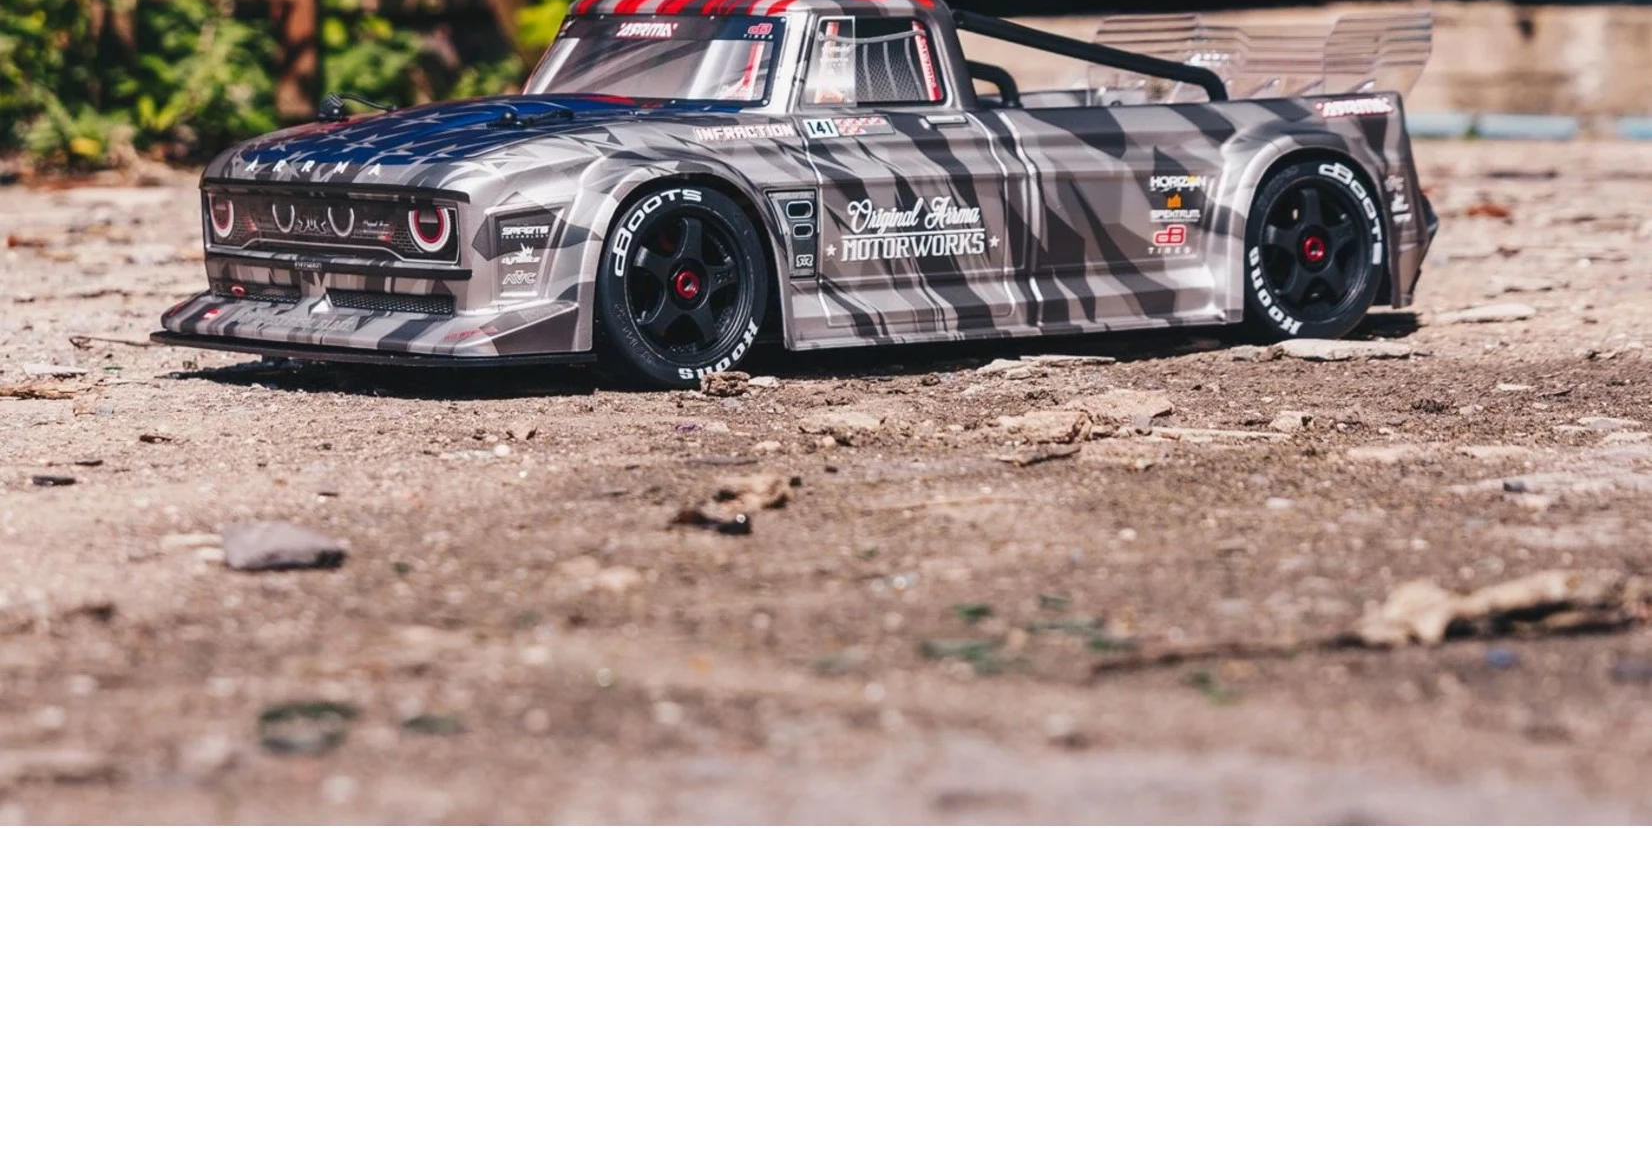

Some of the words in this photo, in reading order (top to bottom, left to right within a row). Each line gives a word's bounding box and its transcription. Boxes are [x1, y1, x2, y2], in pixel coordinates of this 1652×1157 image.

[694, 123, 795, 142] INFRACTION
[807, 121, 832, 135] 141
[245, 156, 382, 176] ARRMA
[847, 197, 924, 235] Original
[840, 233, 985, 262] MOTORWORKS
[502, 270, 537, 285] AVC
